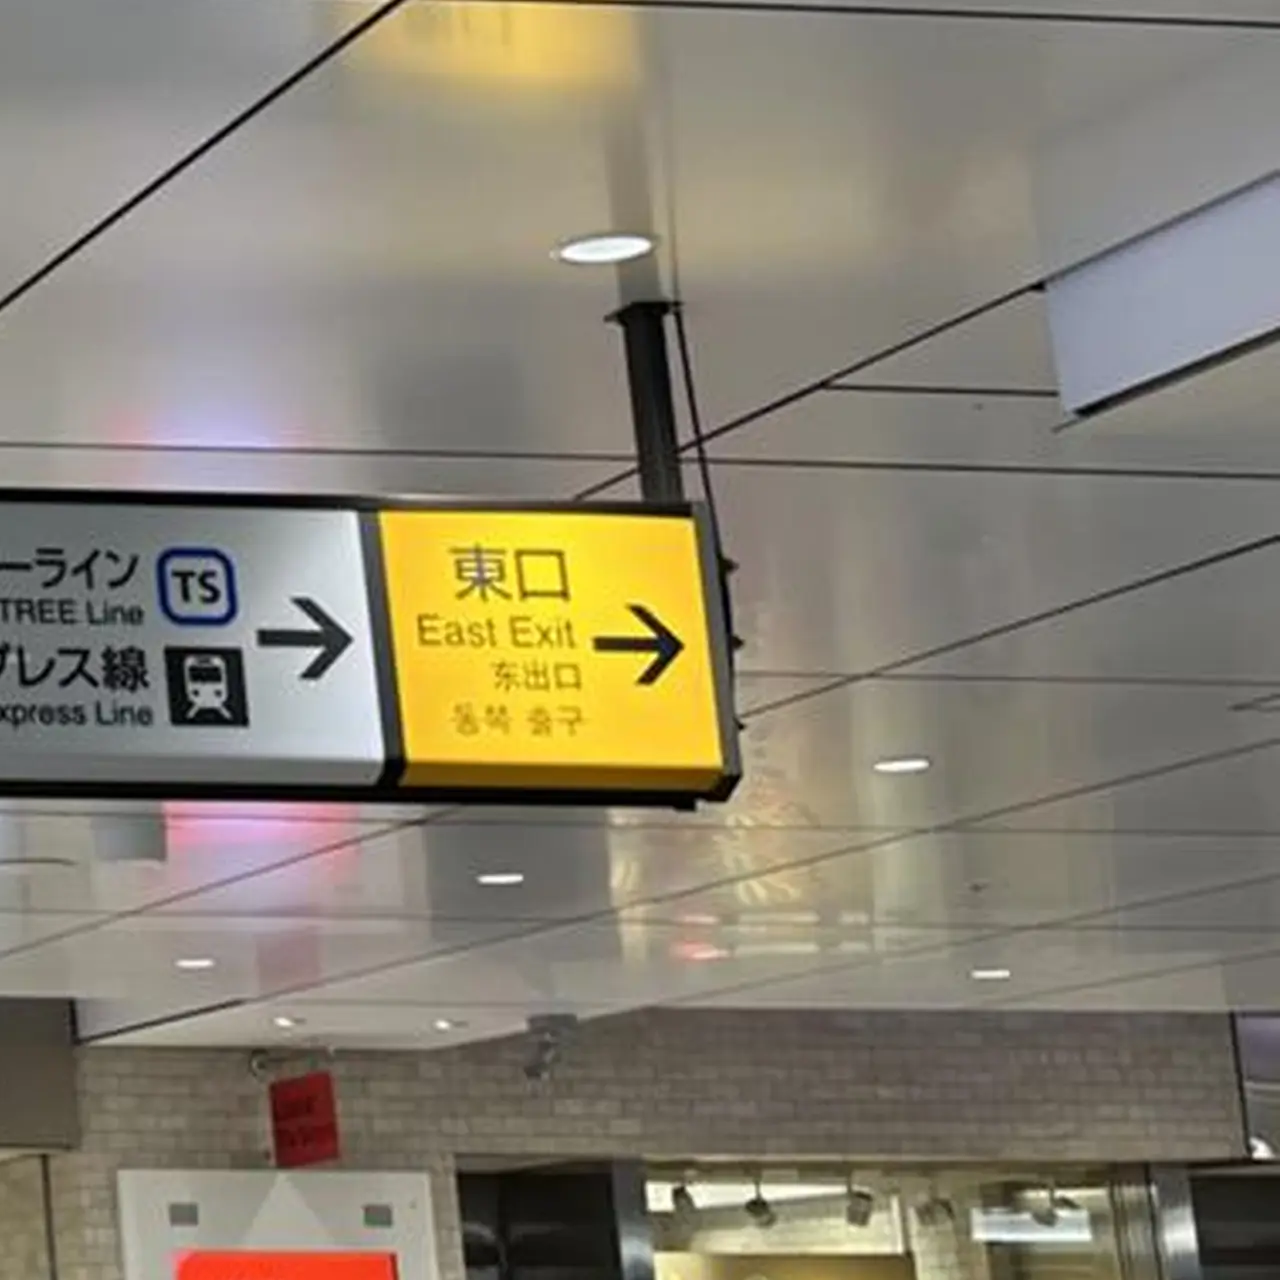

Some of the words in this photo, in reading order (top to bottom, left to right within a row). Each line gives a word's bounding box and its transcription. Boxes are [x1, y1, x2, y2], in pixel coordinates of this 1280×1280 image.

[171, 569, 222, 605] TS
[448, 543, 571, 603] 東口
[86, 598, 145, 627] Line
[416, 613, 497, 648] East
[509, 616, 578, 651] Exit
[491, 660, 583, 693] 东出口
[95, 699, 154, 727] Line
